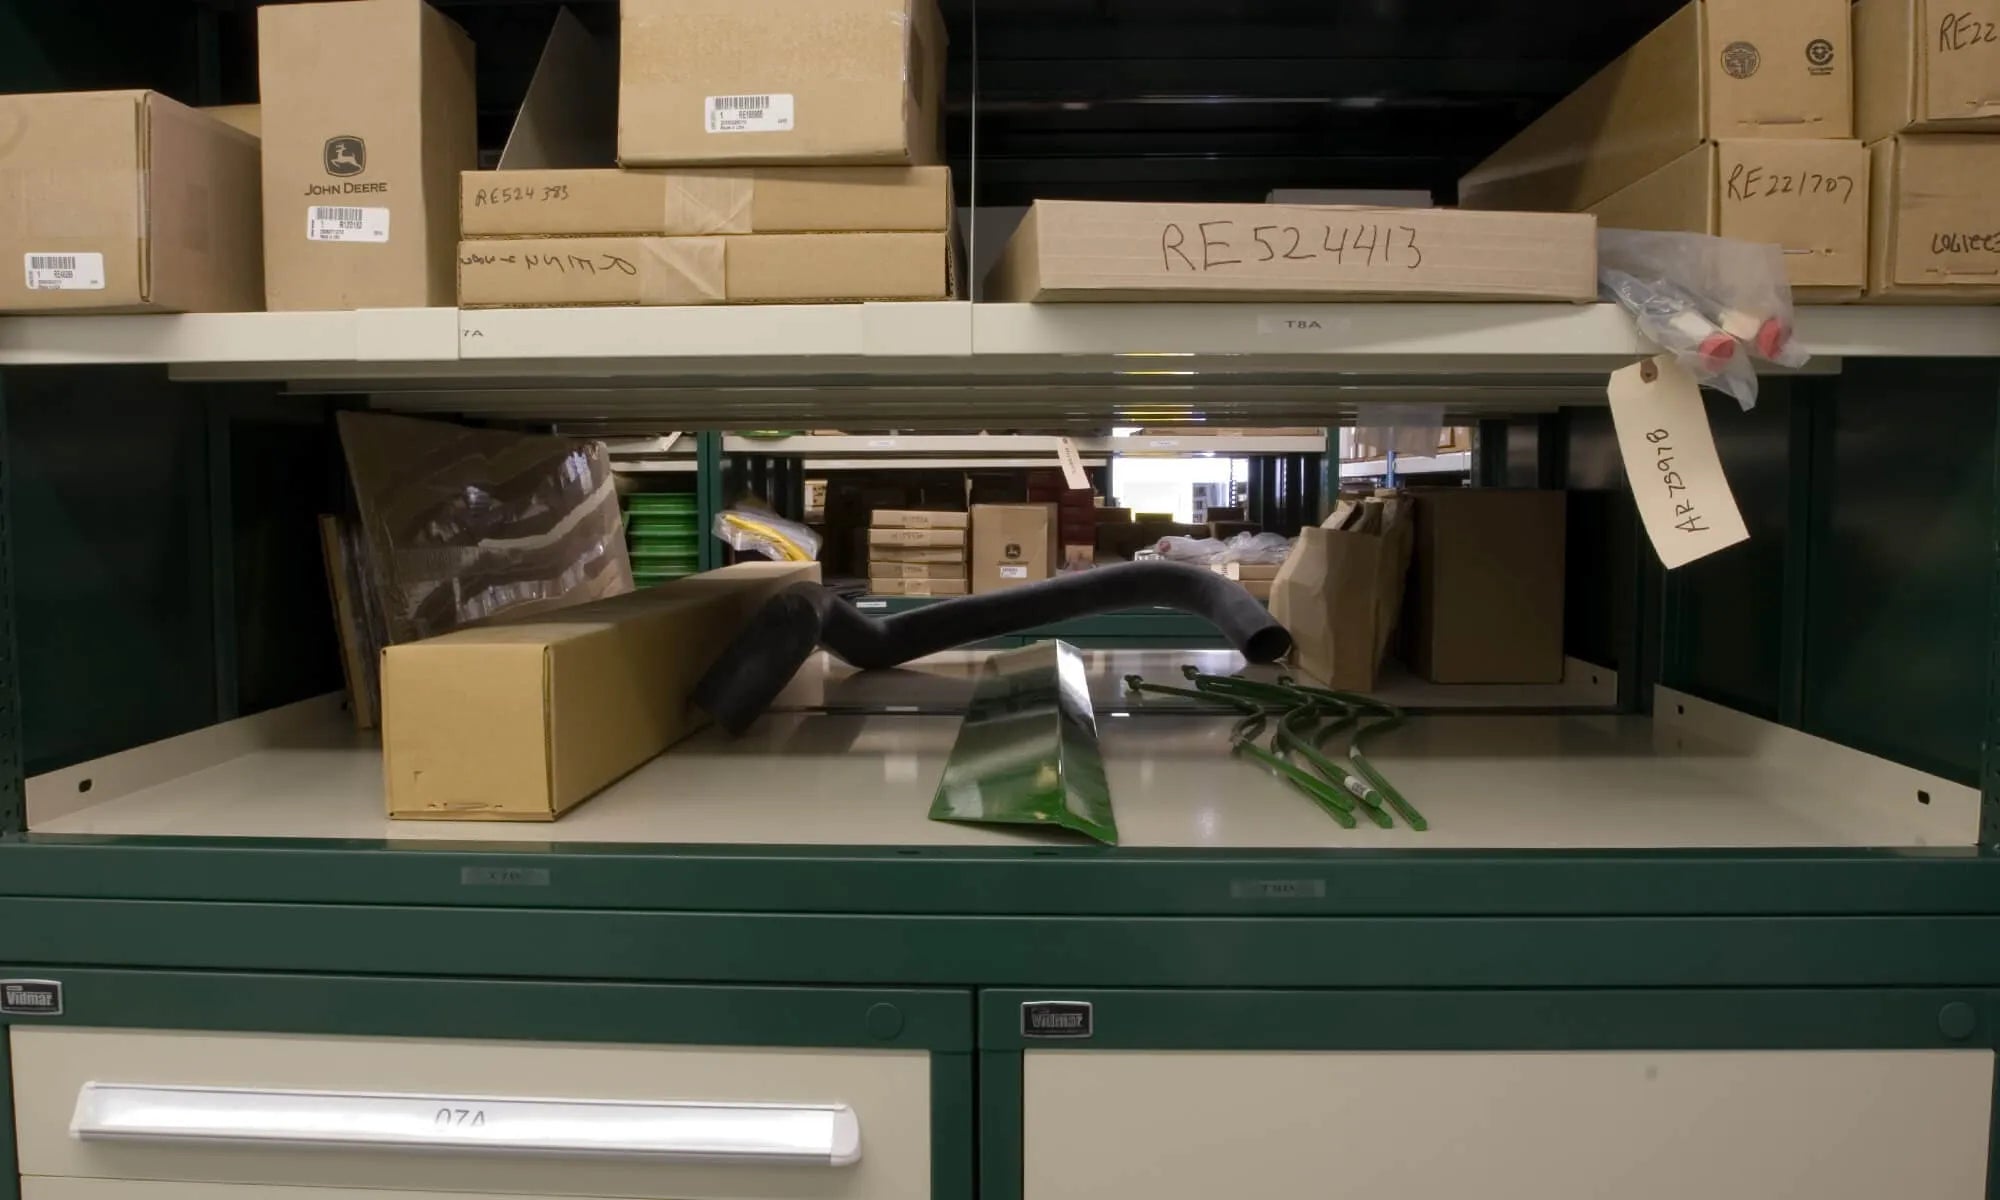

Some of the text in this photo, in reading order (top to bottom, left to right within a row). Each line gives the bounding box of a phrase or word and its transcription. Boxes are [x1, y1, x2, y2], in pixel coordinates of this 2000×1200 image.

[303, 182, 389, 196] JOHN DEERE
[1726, 163, 1854, 204] RE221707
[1284, 319, 1323, 330] T8A
